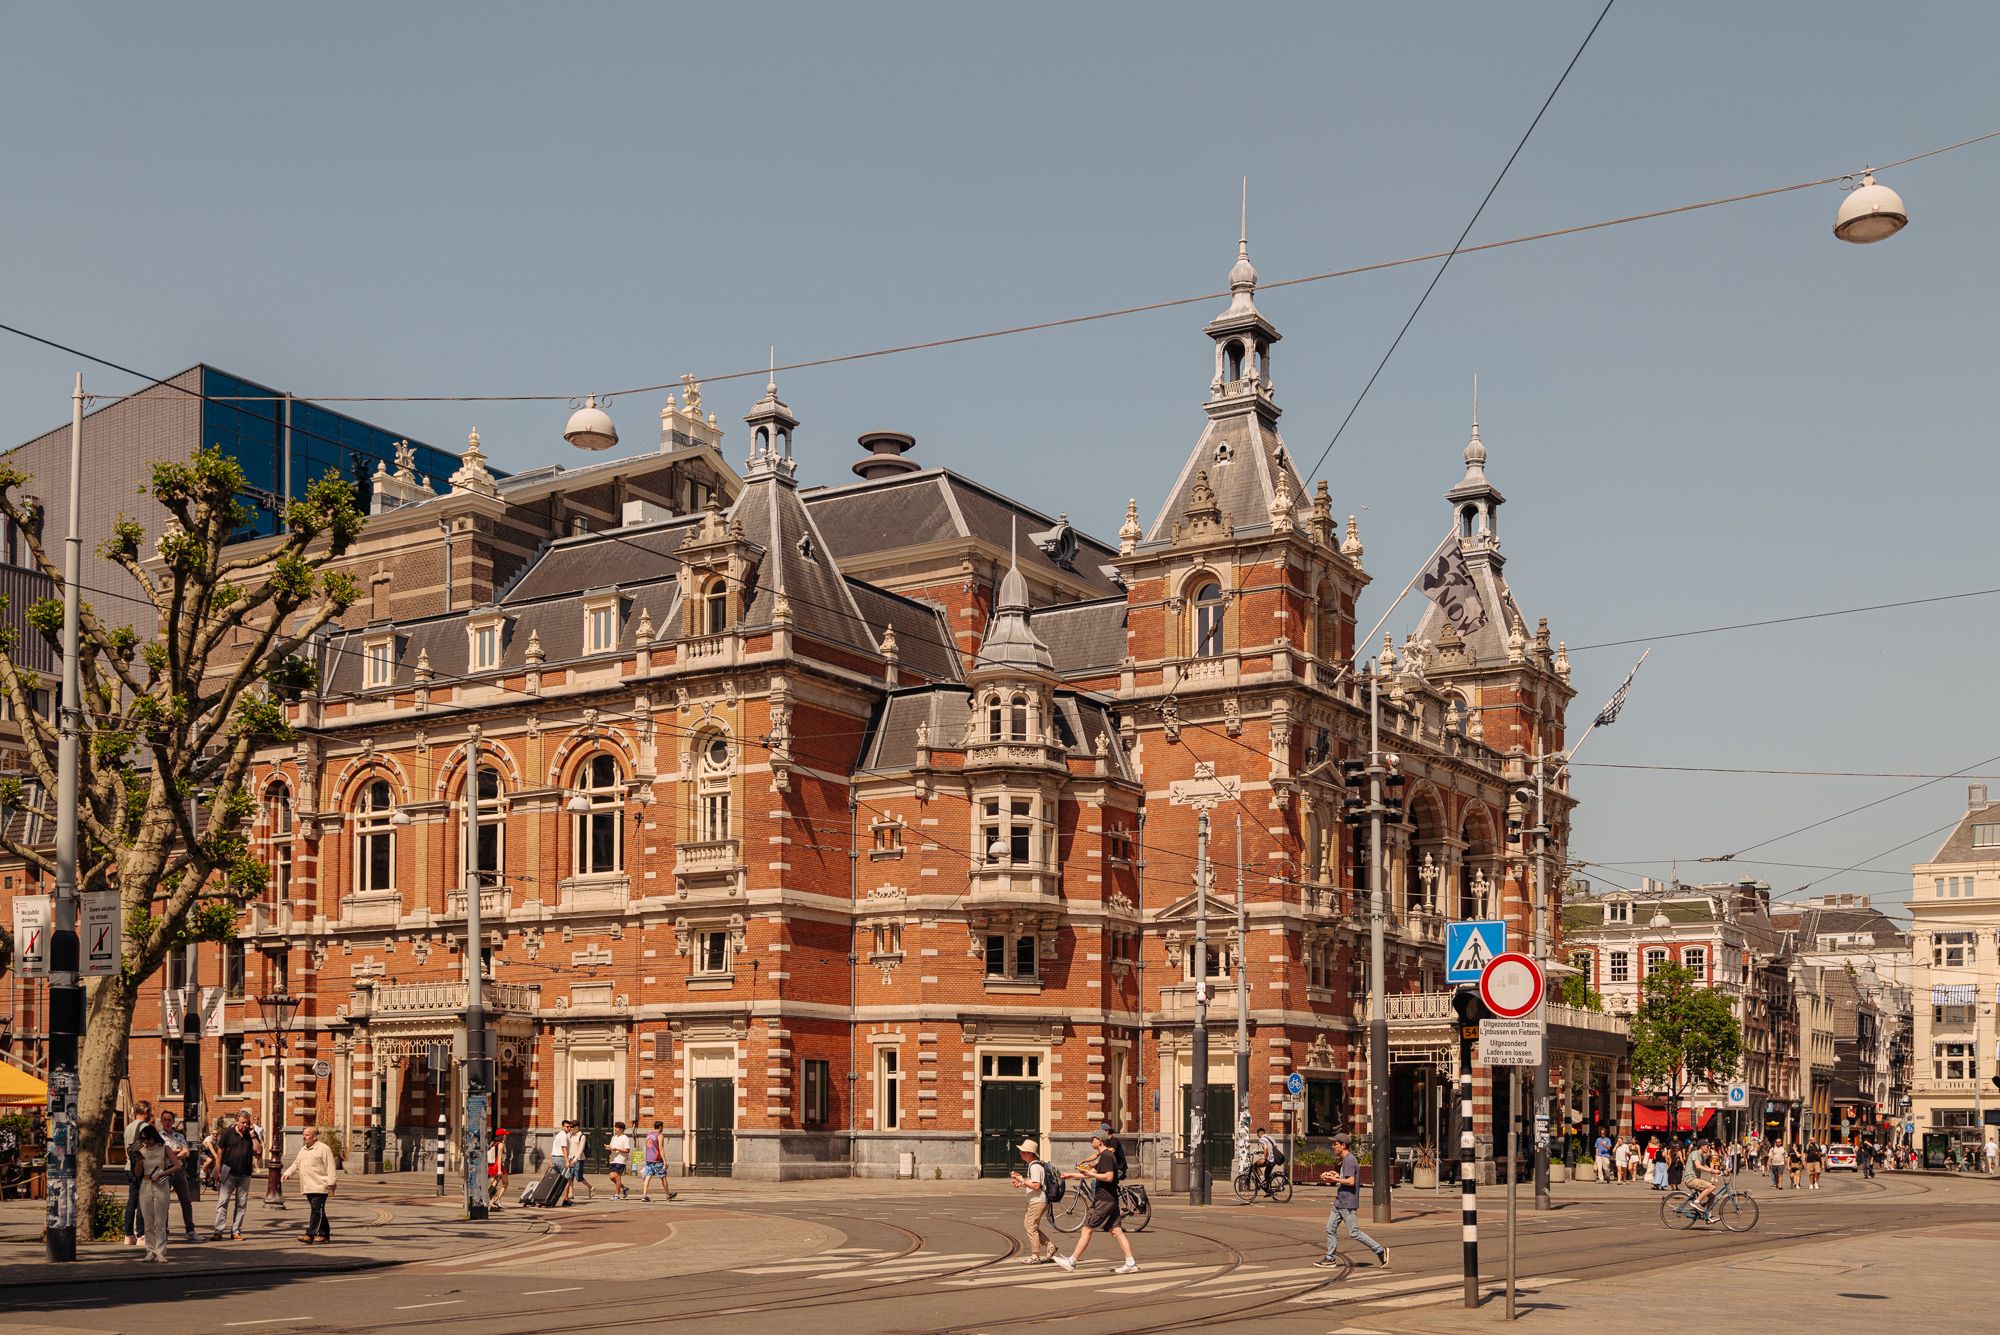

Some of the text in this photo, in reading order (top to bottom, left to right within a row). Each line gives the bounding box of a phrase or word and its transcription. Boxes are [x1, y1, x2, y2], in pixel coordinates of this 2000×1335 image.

[1436, 587, 1479, 637] NOW
[1465, 1028, 1477, 1037] 54
[1480, 1028, 1509, 1036] Ljnbussen
[1490, 1039, 1527, 1047] Uitgezonderd
